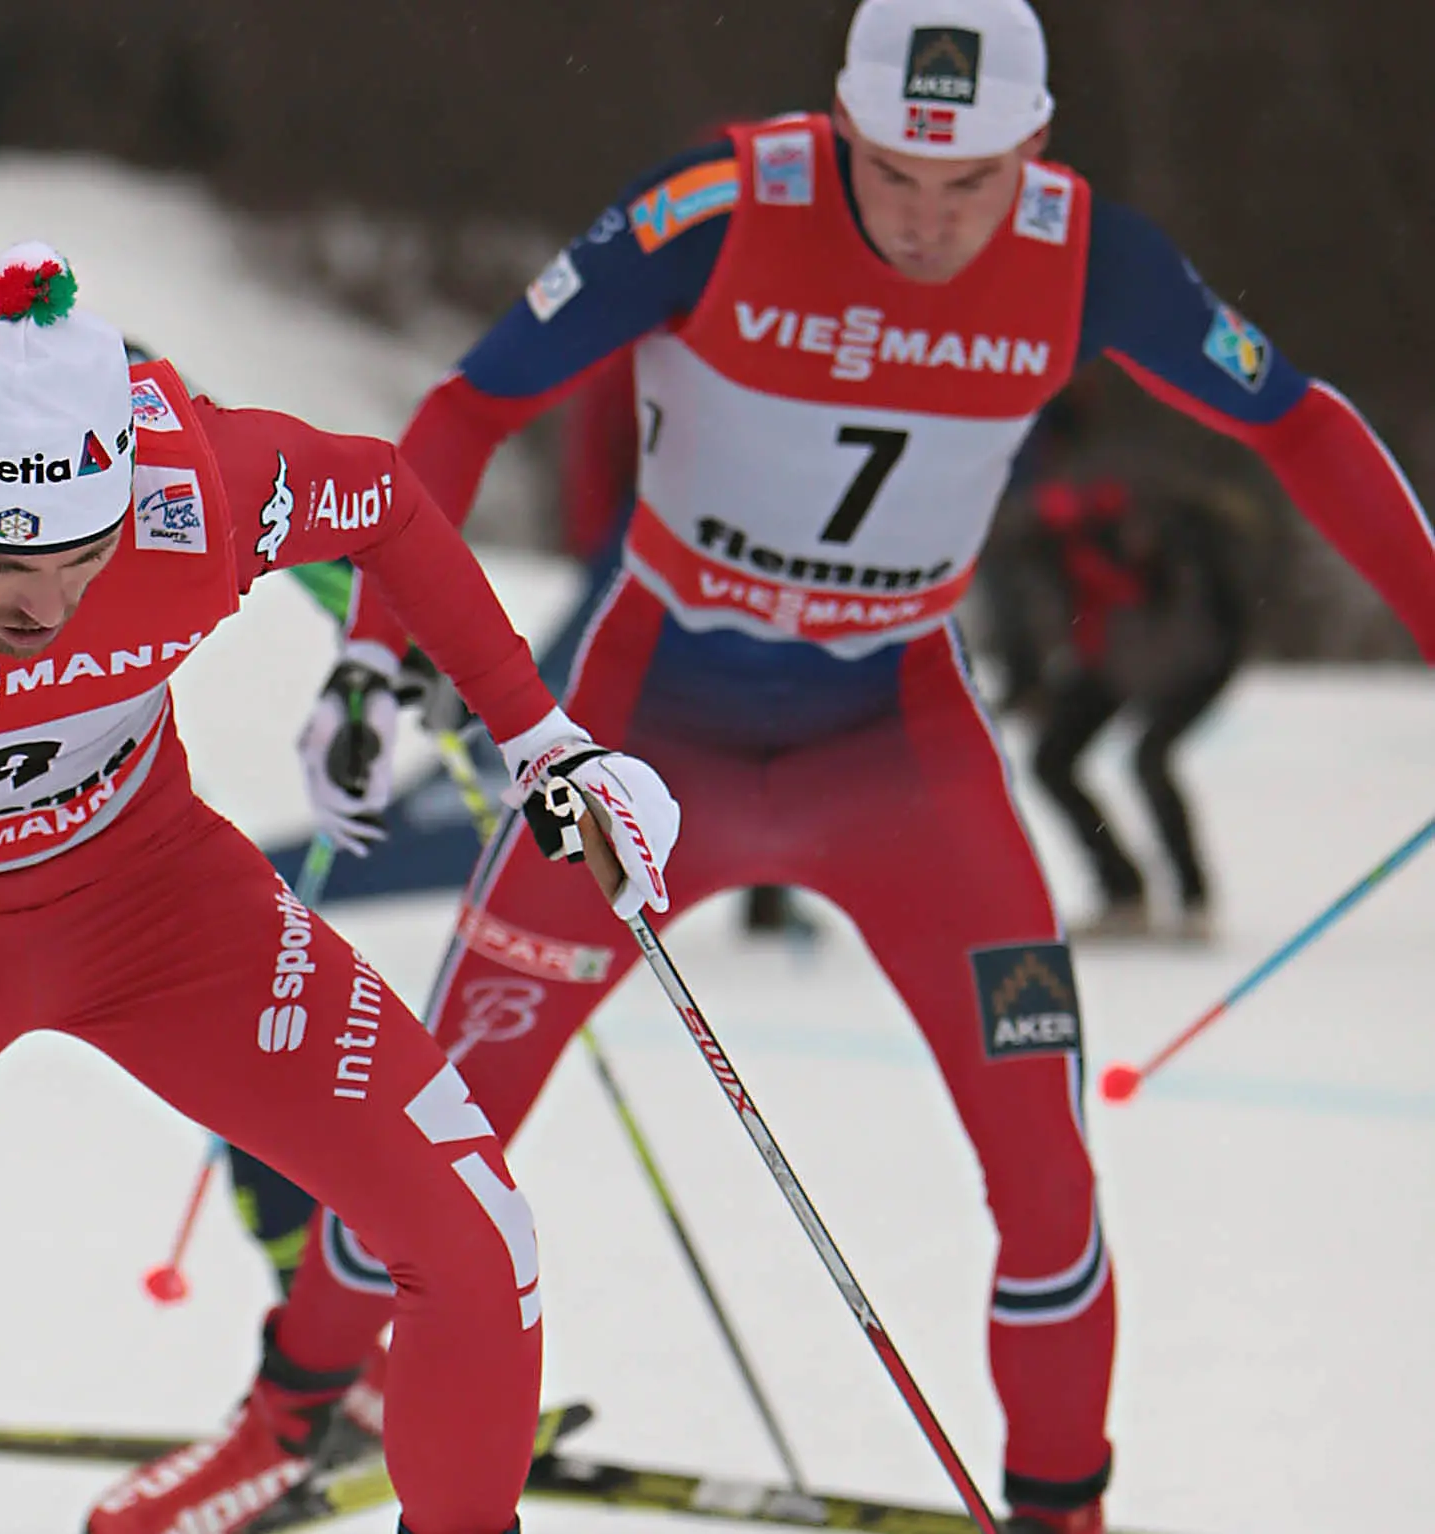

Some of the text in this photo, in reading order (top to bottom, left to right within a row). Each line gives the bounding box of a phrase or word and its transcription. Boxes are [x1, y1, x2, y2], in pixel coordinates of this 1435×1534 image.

[733, 301, 1051, 382] VIESSMANN
[315, 472, 393, 531] Audi
[818, 424, 910, 546] 7
[994, 1013, 1076, 1048] AKER
